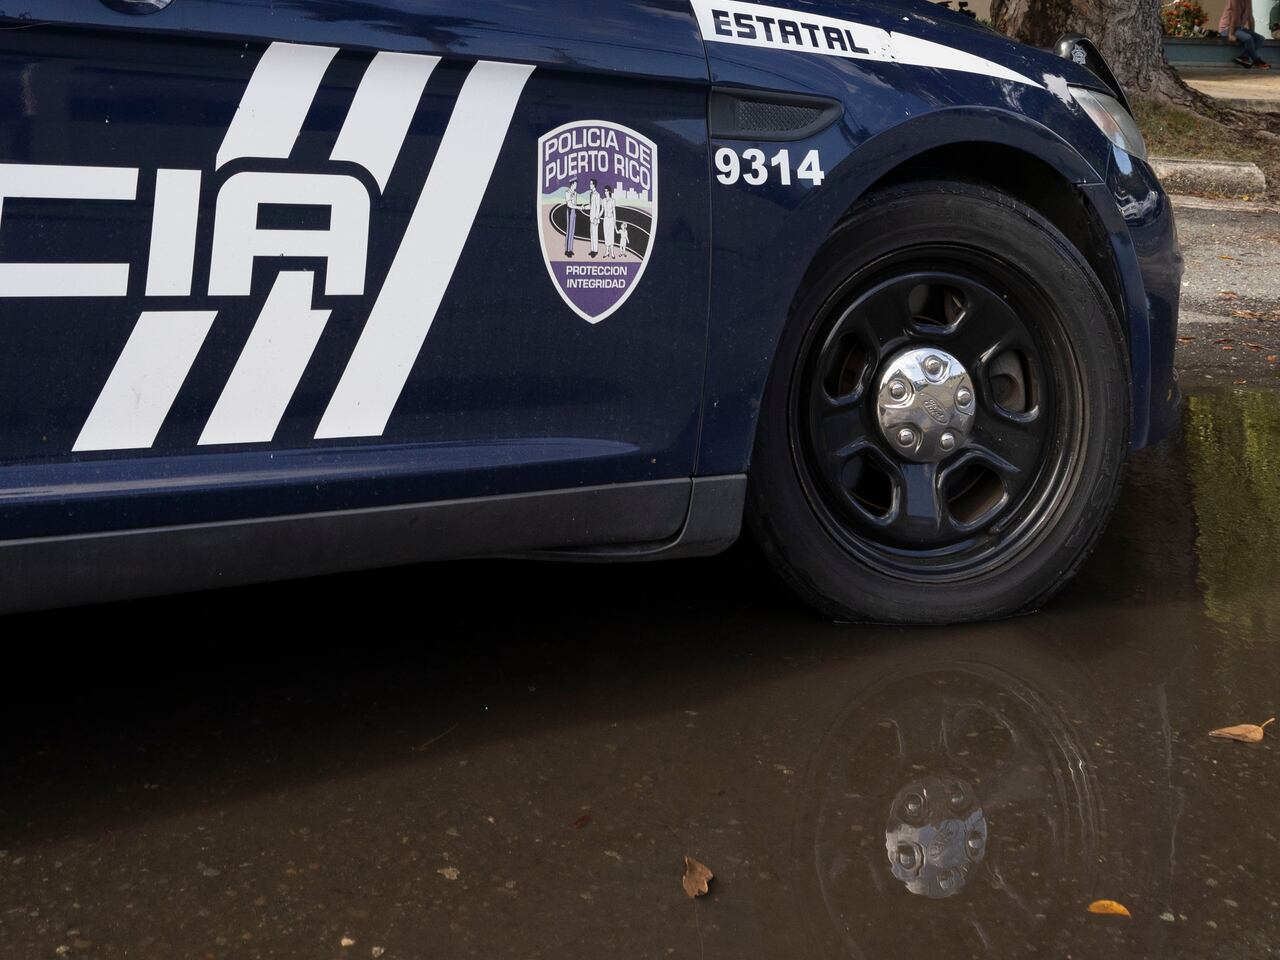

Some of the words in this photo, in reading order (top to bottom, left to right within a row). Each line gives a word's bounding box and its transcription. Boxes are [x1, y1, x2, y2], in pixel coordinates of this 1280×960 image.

[711, 9, 869, 55] ESTATAL
[545, 128, 619, 162] POLICIA
[625, 136, 651, 169] DE
[714, 147, 825, 187] 9314
[545, 151, 609, 188] PUERTO
[614, 153, 651, 191] RICO
[566, 265, 628, 277] PROTECCION
[566, 278, 626, 289] INTEGRIDAD
